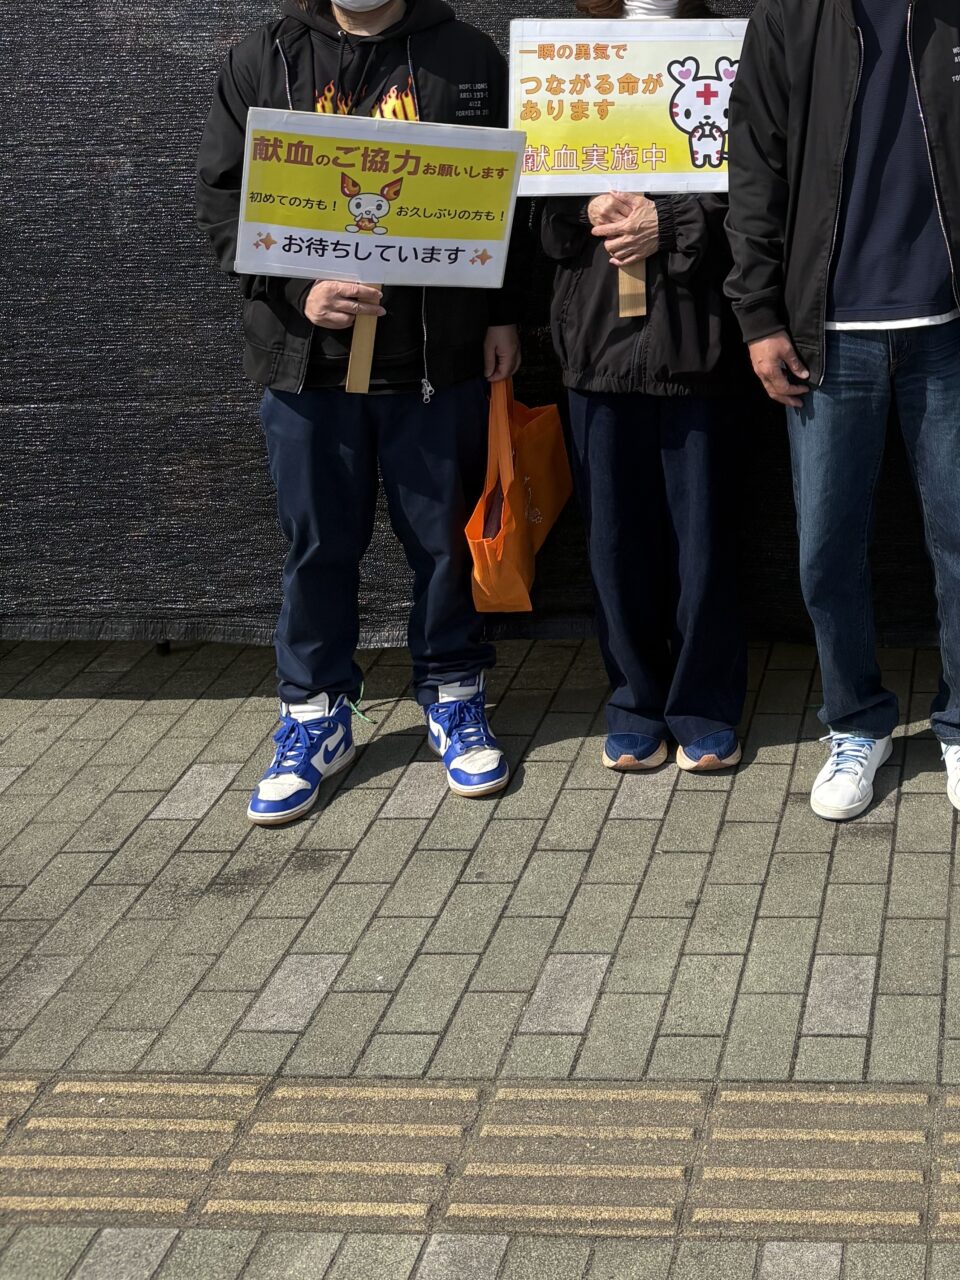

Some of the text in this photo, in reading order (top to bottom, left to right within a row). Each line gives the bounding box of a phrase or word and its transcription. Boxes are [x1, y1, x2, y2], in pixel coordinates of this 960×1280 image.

[519, 43, 628, 61] 一瞬の勇気で
[519, 73, 664, 96] つながる命が
[520, 99, 615, 121] あります
[252, 135, 509, 180] 献血のご協力お願いします
[522, 143, 667, 173] 献血実施中
[249, 191, 506, 222] 初めての方も！ お久しぶりの方も！
[281, 234, 466, 265] お待ちしています
